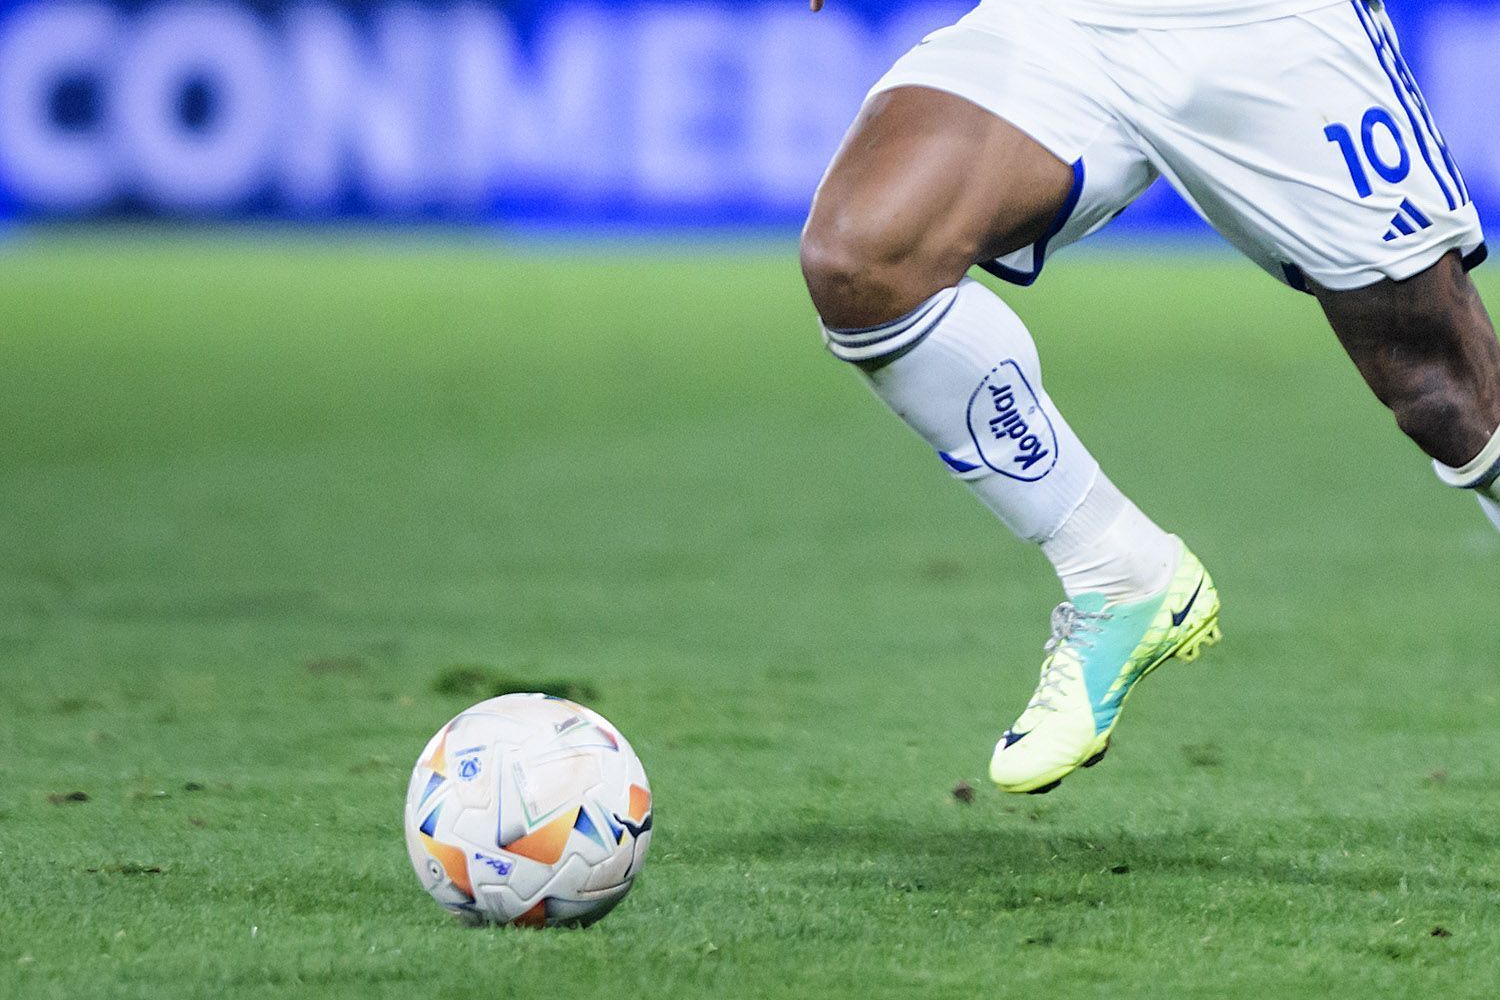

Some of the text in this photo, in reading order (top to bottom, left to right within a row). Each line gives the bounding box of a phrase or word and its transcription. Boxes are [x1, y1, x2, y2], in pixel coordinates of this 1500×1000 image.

[0, 0, 985, 205] CONMEB
[1323, 106, 1411, 199] 10
[988, 384, 1049, 470] Kodilar
